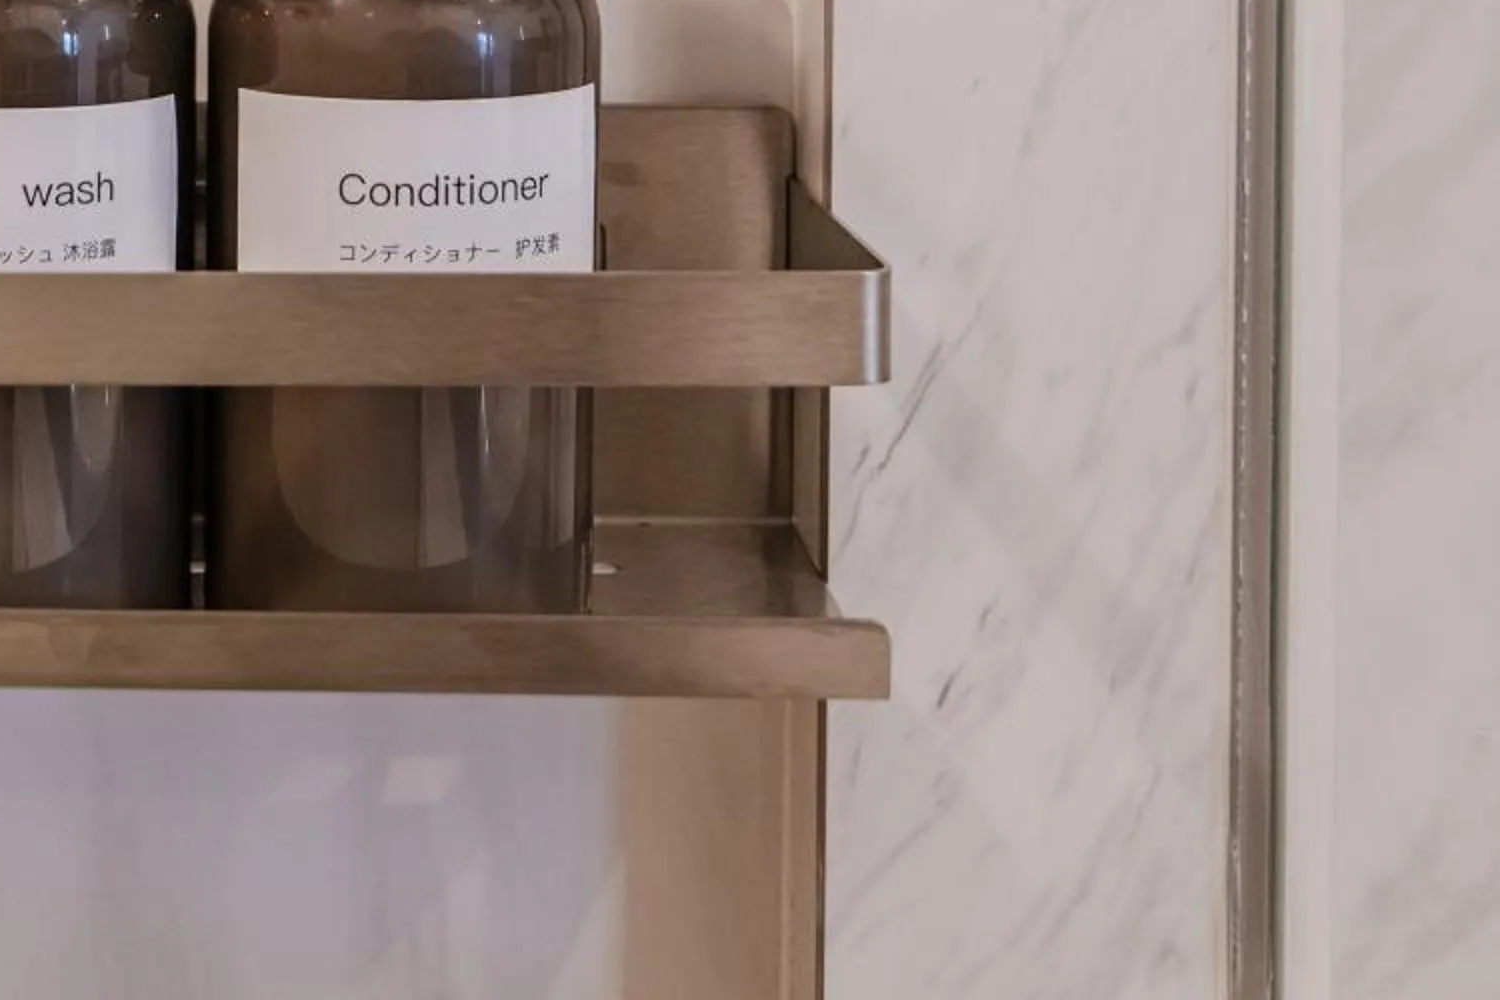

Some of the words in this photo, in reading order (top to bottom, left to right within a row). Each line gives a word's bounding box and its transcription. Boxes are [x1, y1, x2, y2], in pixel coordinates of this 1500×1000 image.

[22, 170, 114, 208] wash
[338, 171, 549, 207] Conditioner
[339, 242, 501, 264] コンディショナー
